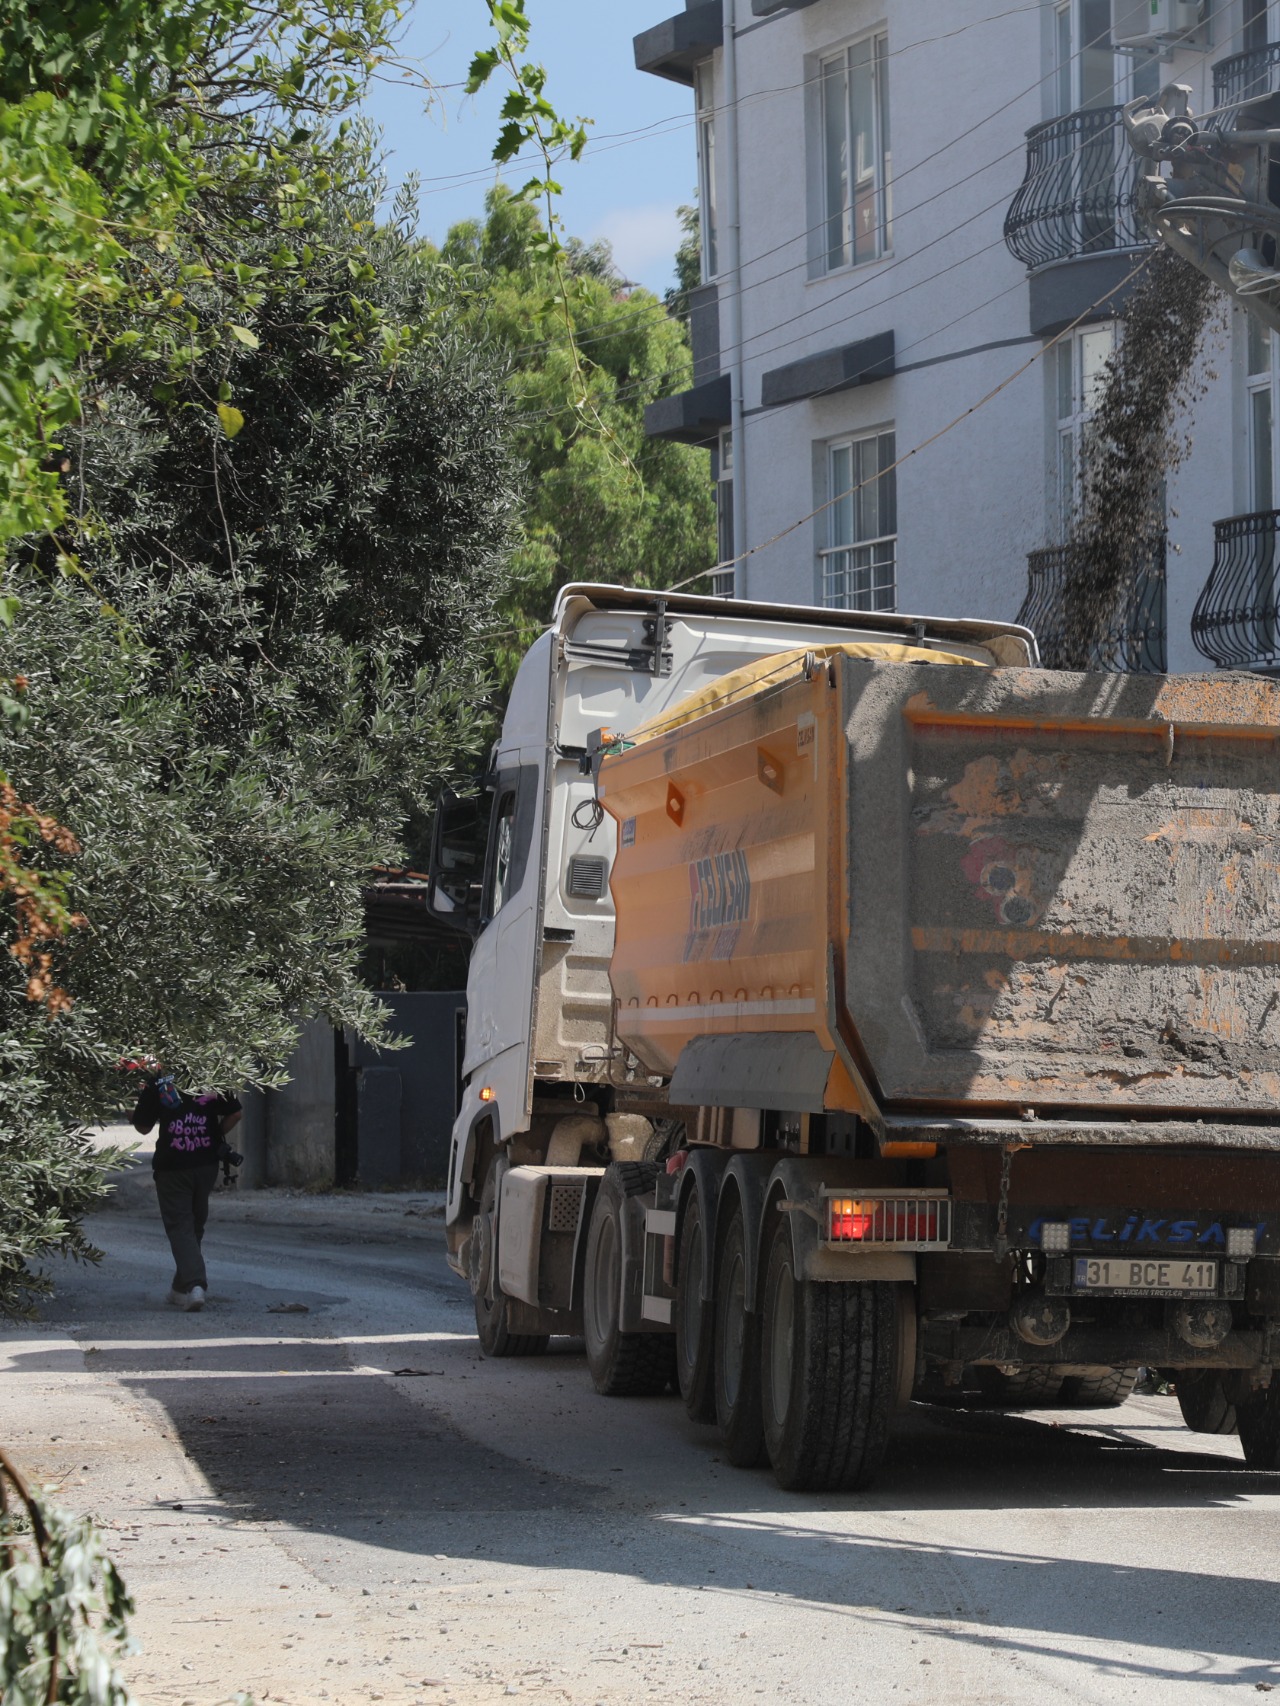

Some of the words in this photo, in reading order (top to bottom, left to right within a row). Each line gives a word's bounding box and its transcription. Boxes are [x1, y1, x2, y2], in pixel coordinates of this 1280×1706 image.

[1087, 1261, 1110, 1285] 31
[1129, 1262, 1171, 1287] BCE
[1181, 1264, 1214, 1288] 411
